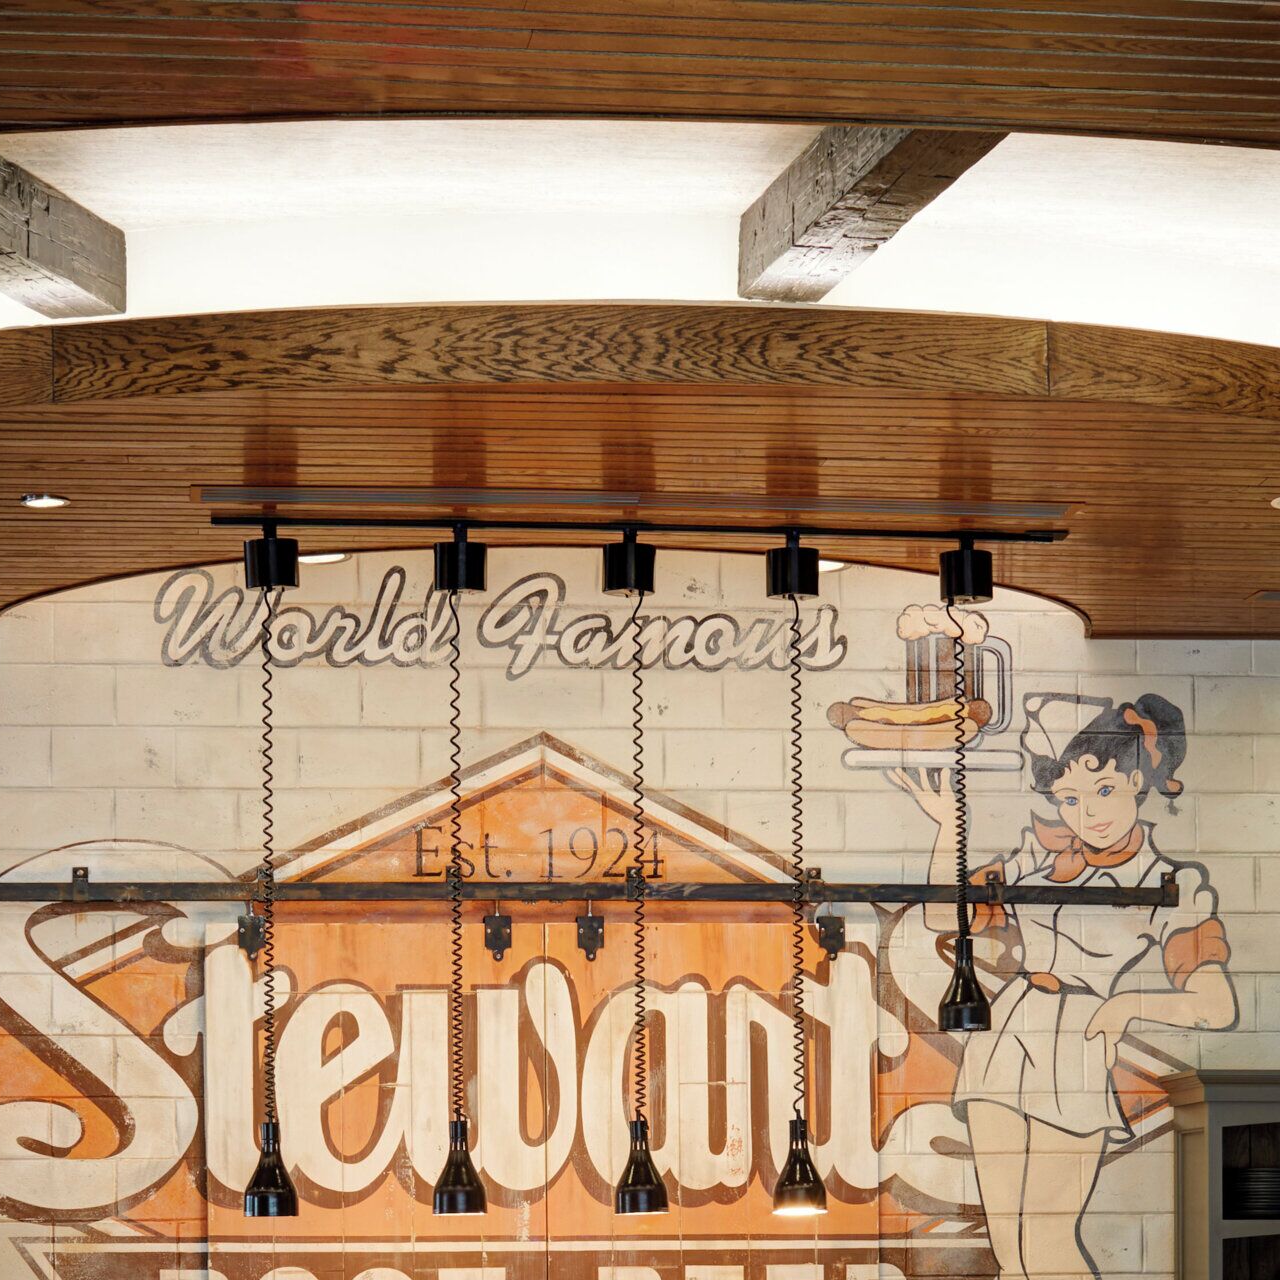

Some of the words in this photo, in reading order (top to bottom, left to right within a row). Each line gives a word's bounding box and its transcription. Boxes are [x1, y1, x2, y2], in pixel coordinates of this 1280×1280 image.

[154, 566, 460, 669] World
[476, 572, 848, 681] Famous
[413, 824, 513, 879] Est.
[538, 826, 665, 880] 1924
